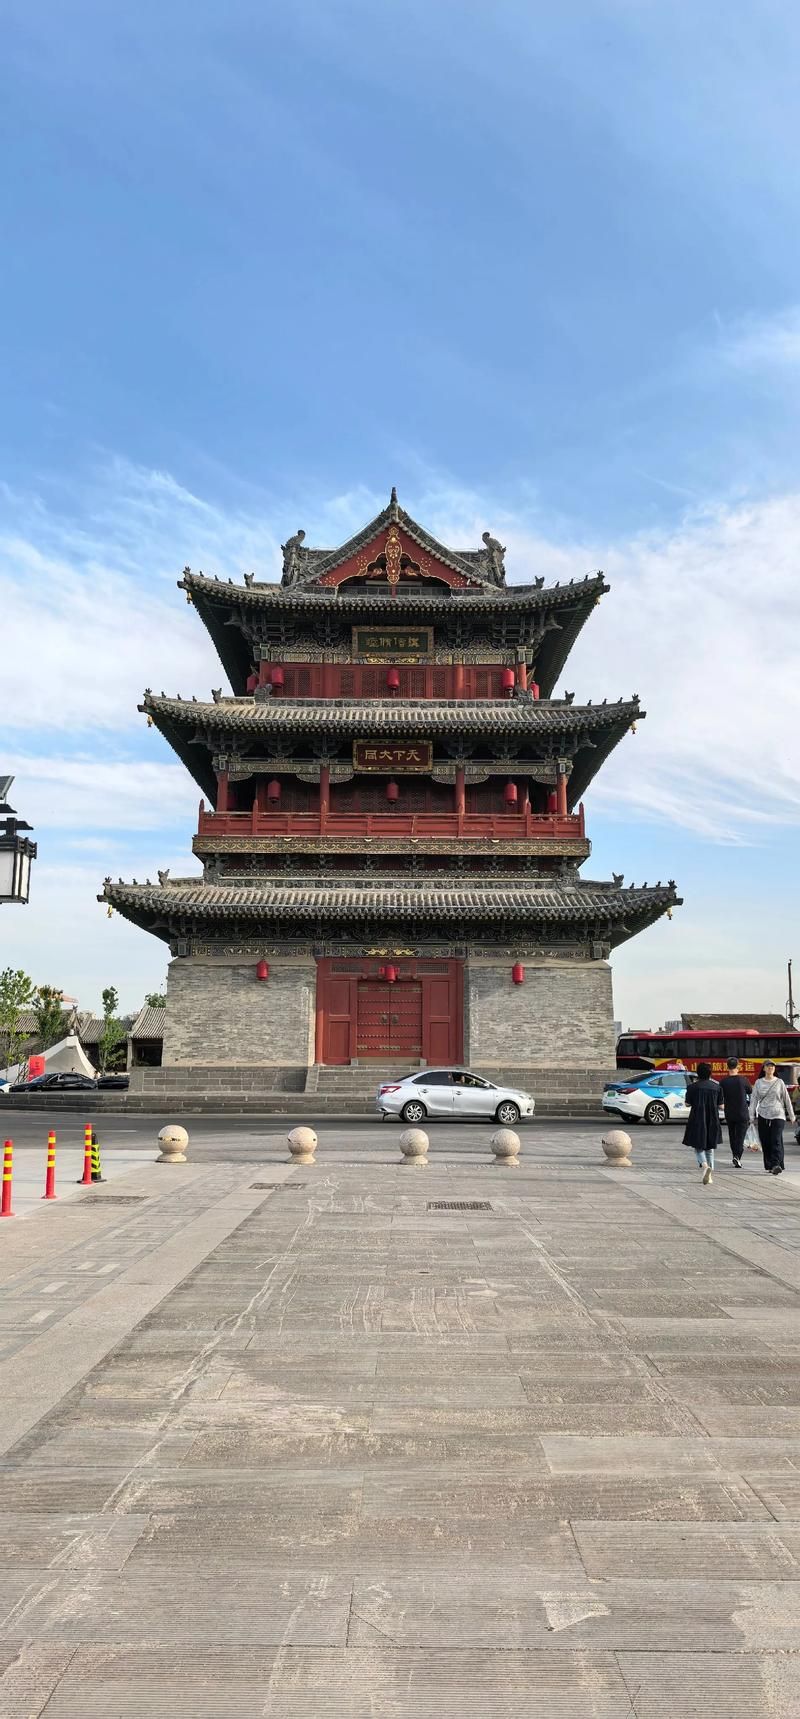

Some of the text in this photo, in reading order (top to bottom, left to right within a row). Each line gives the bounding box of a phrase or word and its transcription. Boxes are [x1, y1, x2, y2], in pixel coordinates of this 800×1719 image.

[364, 749, 421, 762] 天下大同
[691, 1062, 755, 1072] 山旅客运
